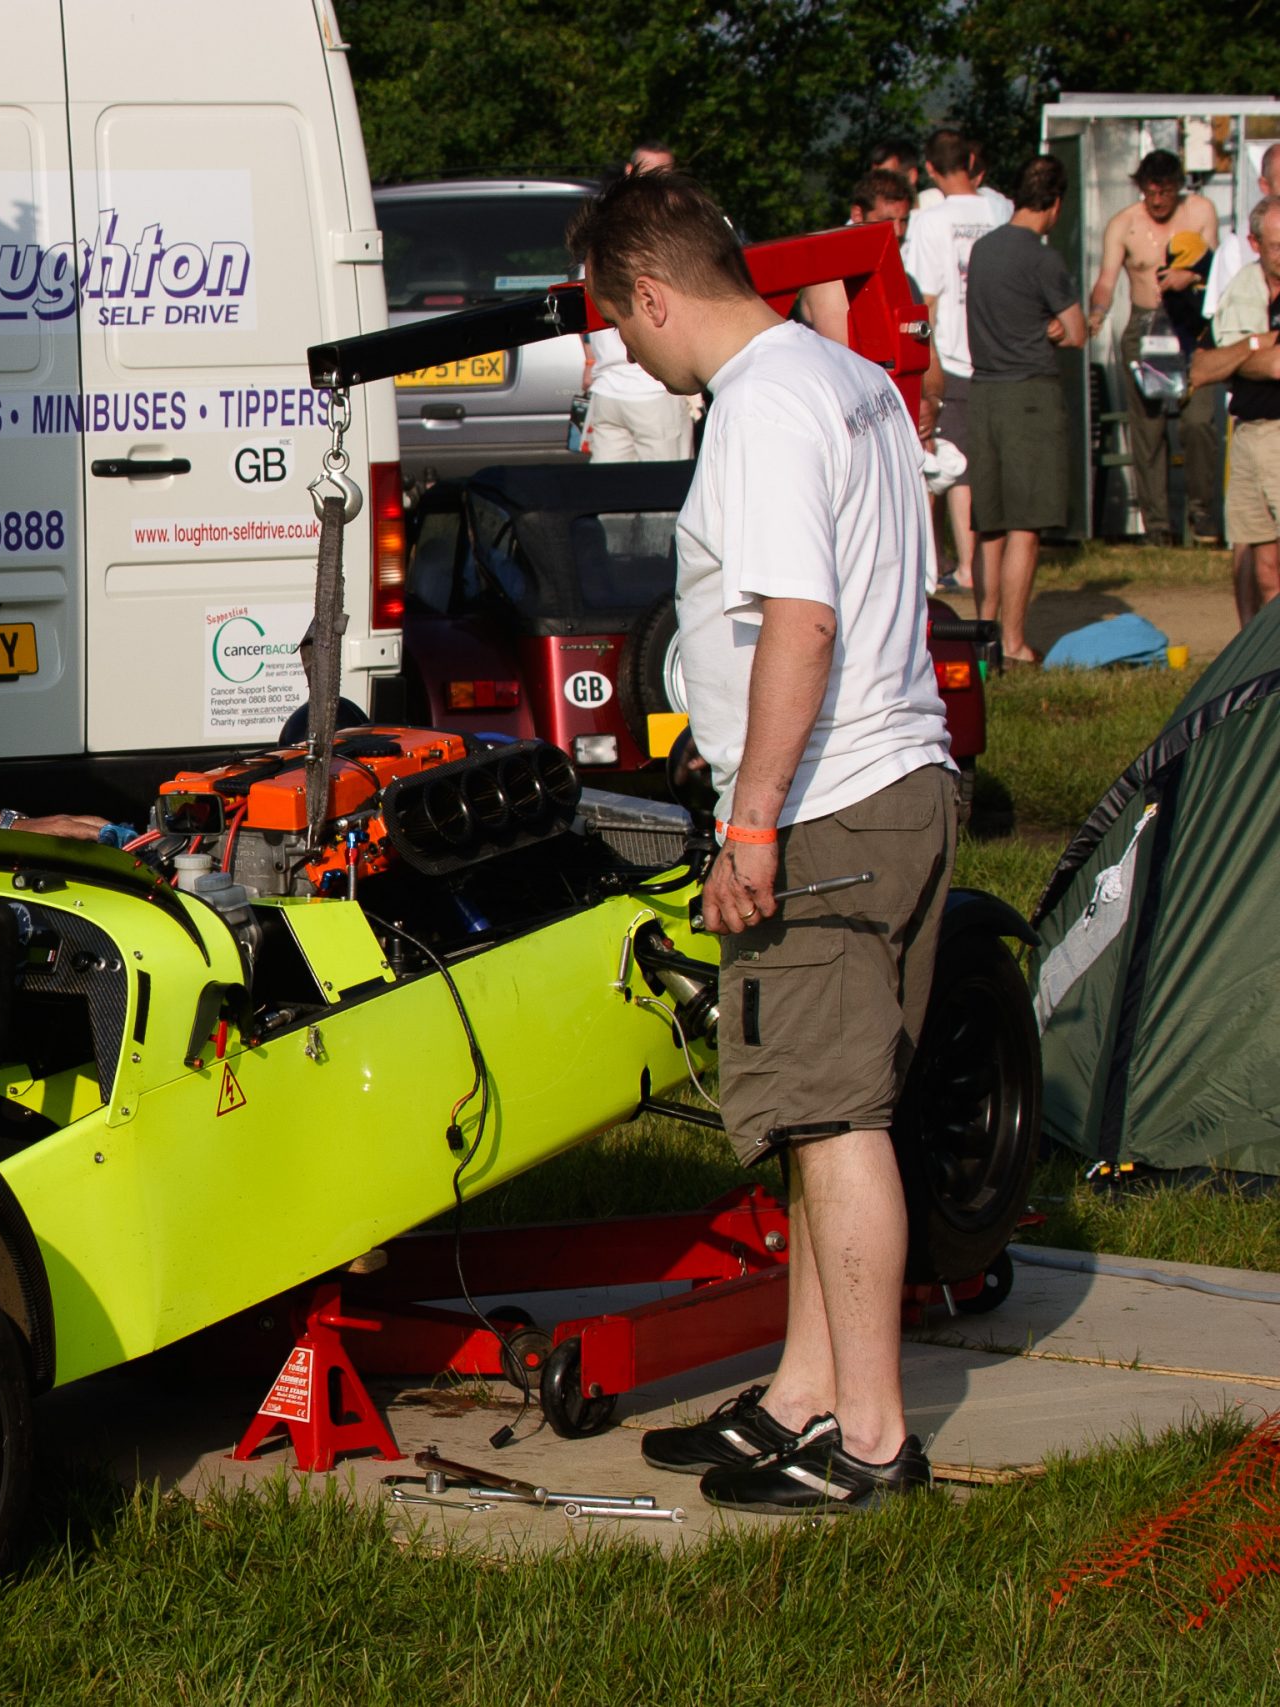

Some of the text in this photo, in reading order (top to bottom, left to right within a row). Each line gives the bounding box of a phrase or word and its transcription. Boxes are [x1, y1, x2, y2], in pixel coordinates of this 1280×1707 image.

[98, 304, 240, 326] SELF DRIVE
[456, 357, 501, 377] FGX
[32, 390, 187, 434] MINIBUSES
[219, 388, 333, 428] TIPPERS
[234, 447, 287, 484] GB
[135, 519, 320, 546] www. loughton-selfdrive.co.uk
[206, 607, 248, 624] Supporting
[210, 685, 293, 696] Cancer Support Service
[573, 676, 604, 702] GB
[210, 694, 300, 707] Freephone 0808 800 1234
[210, 707, 239, 716] Website:
[210, 717, 235, 727] Charity
[237, 716, 276, 726] registration
[295, 1352, 306, 1364] 2
